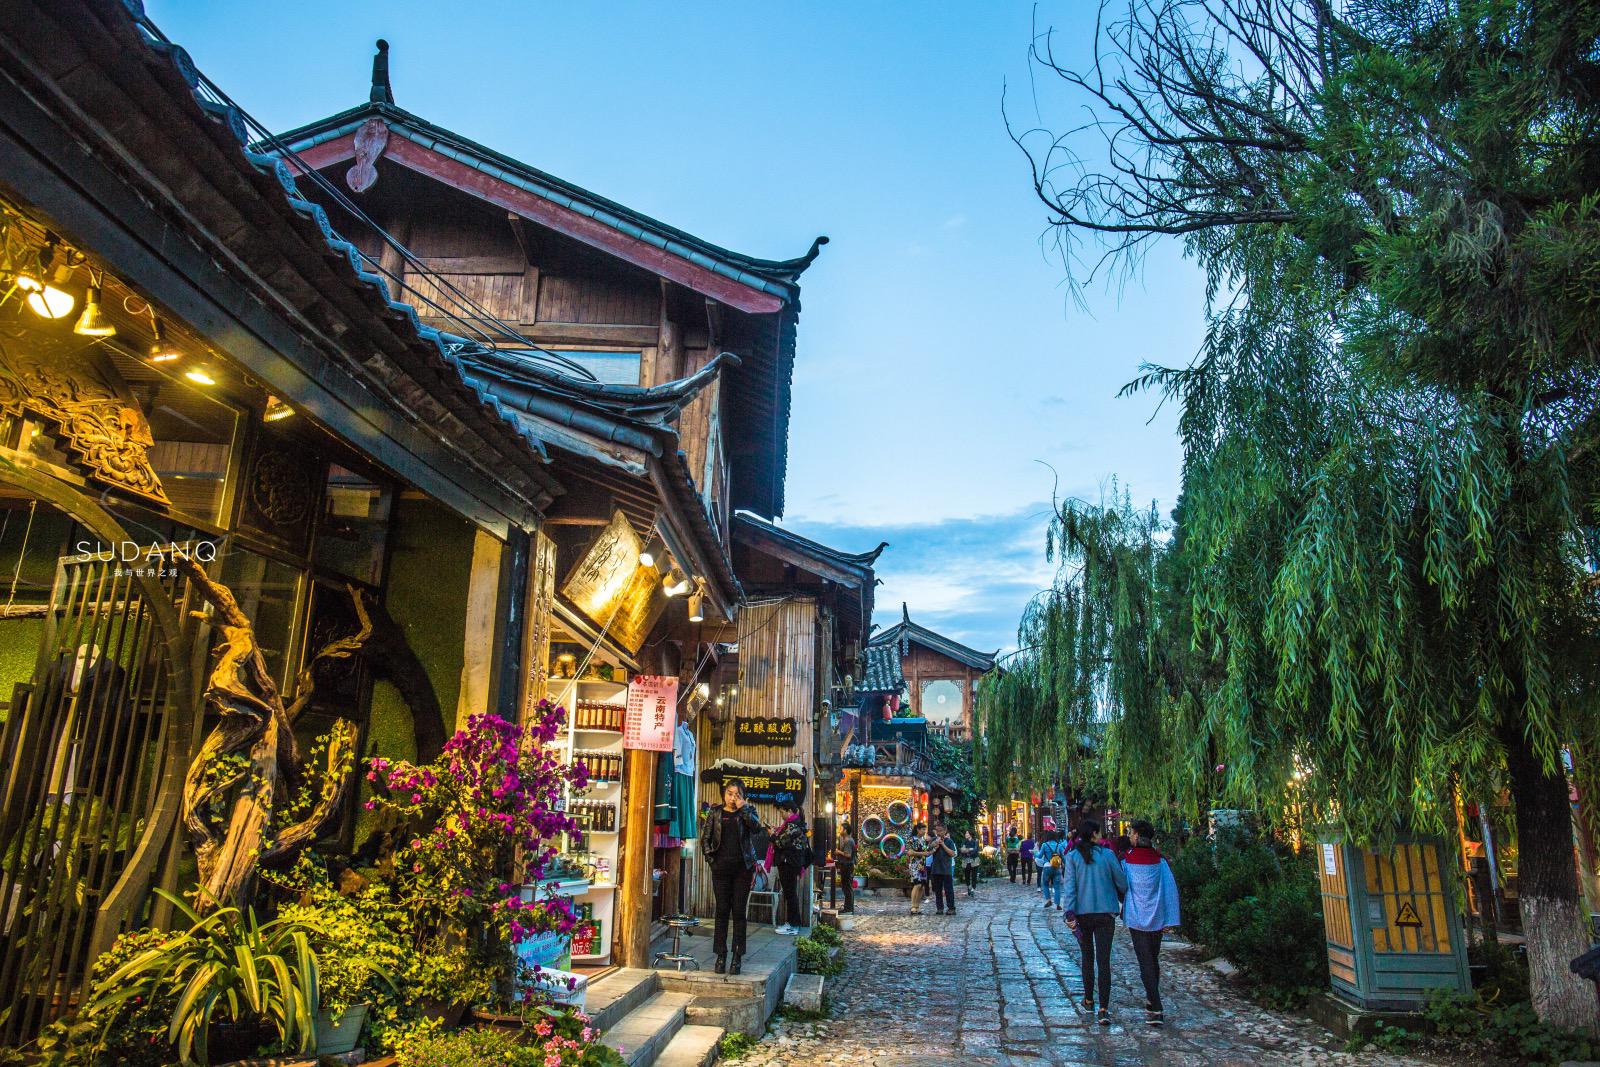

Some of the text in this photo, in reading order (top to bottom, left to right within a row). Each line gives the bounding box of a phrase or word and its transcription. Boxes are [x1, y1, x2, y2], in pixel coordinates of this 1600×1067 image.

[654, 697, 667, 730] 云南特产
[739, 722, 792, 734] 现酿酸奶
